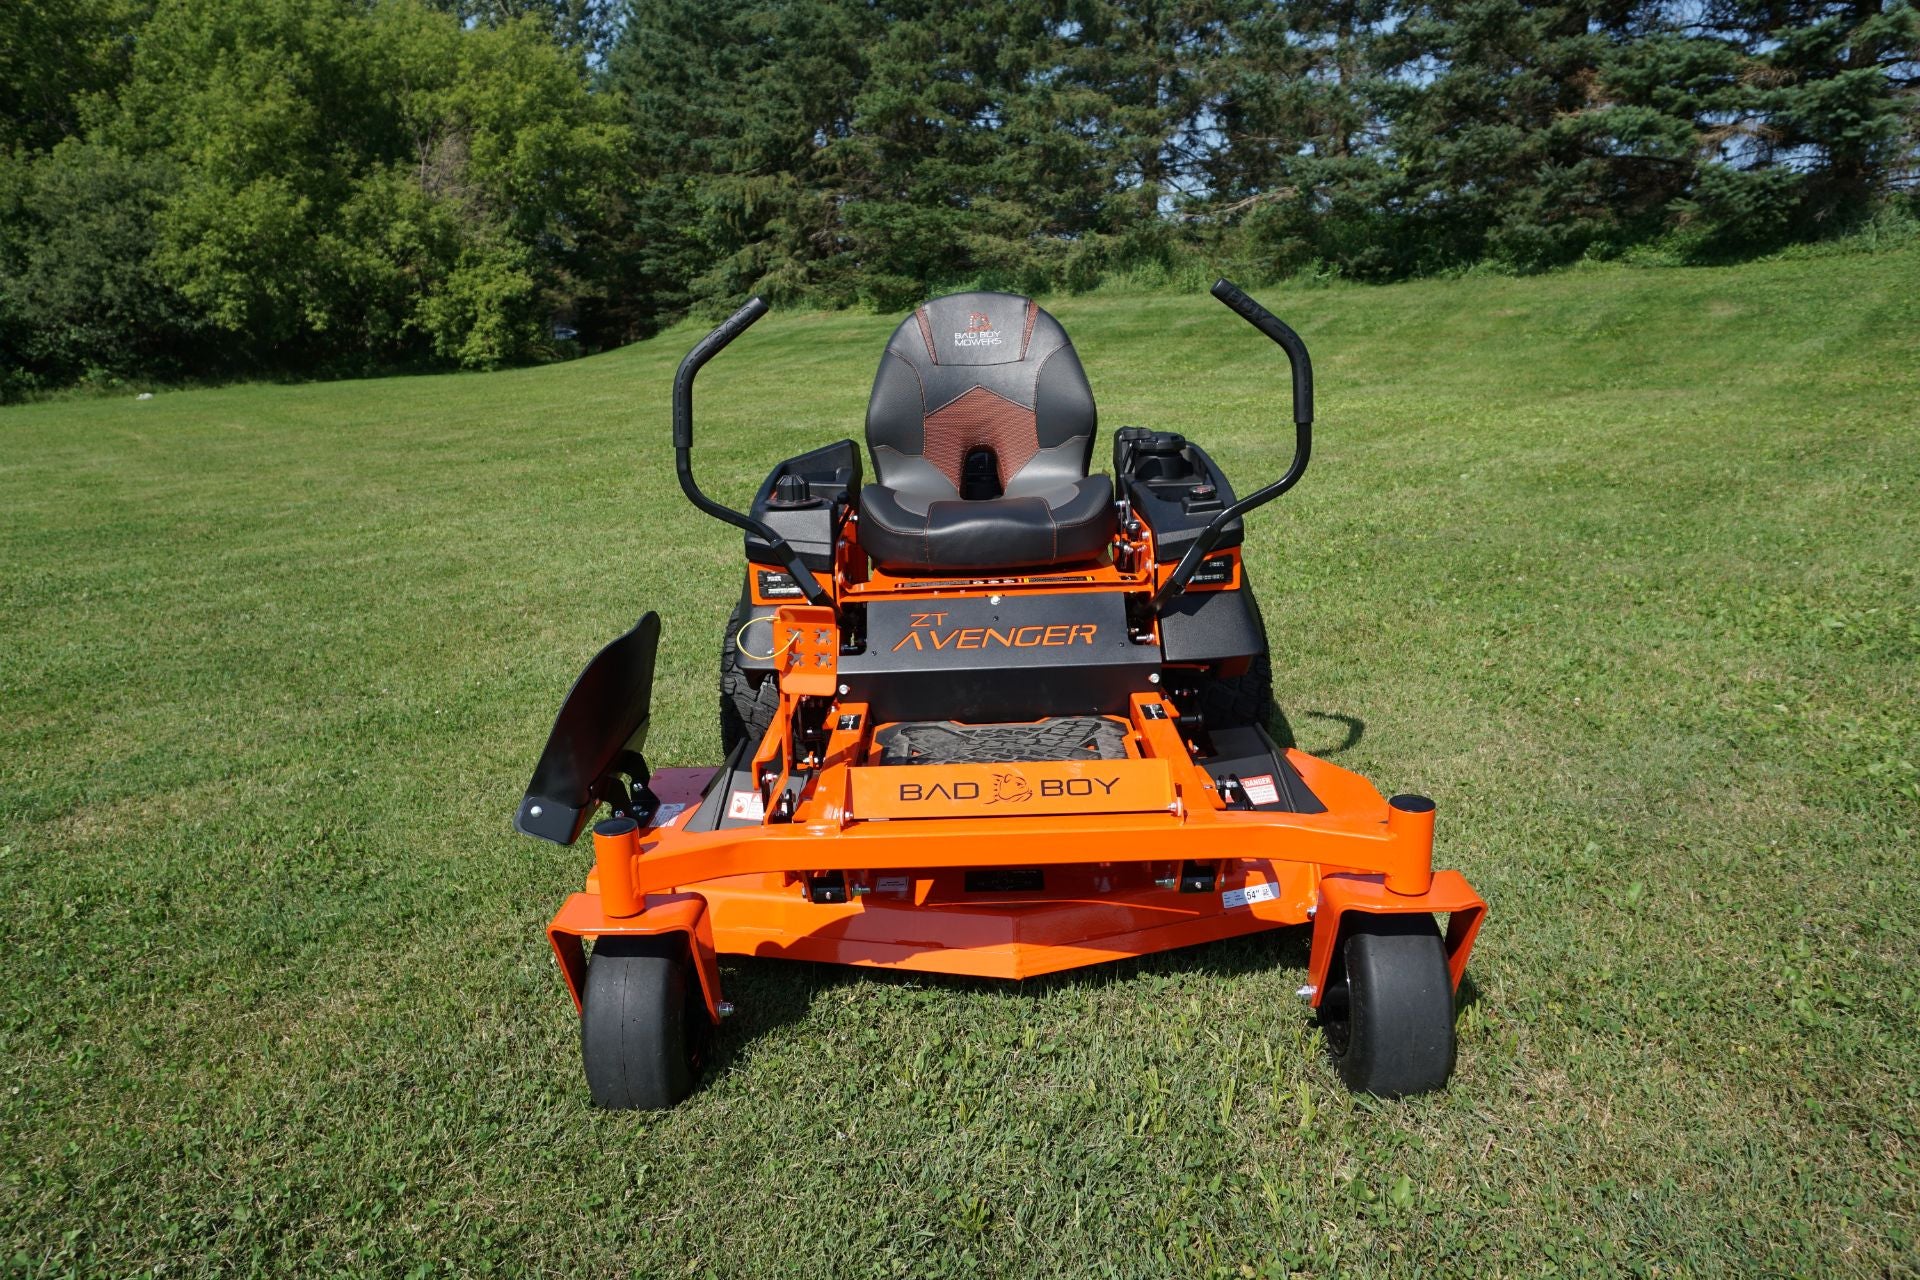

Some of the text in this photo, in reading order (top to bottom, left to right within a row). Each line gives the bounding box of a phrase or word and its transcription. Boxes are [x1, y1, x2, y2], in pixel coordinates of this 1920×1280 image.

[954, 330, 1001, 340] BAD BOY
[954, 337, 1002, 347] MOWERS
[910, 612, 949, 627] ZT
[891, 624, 1098, 652] AVENGER
[1244, 777, 1271, 787] DANGER
[899, 777, 1120, 801] BAD BOY
